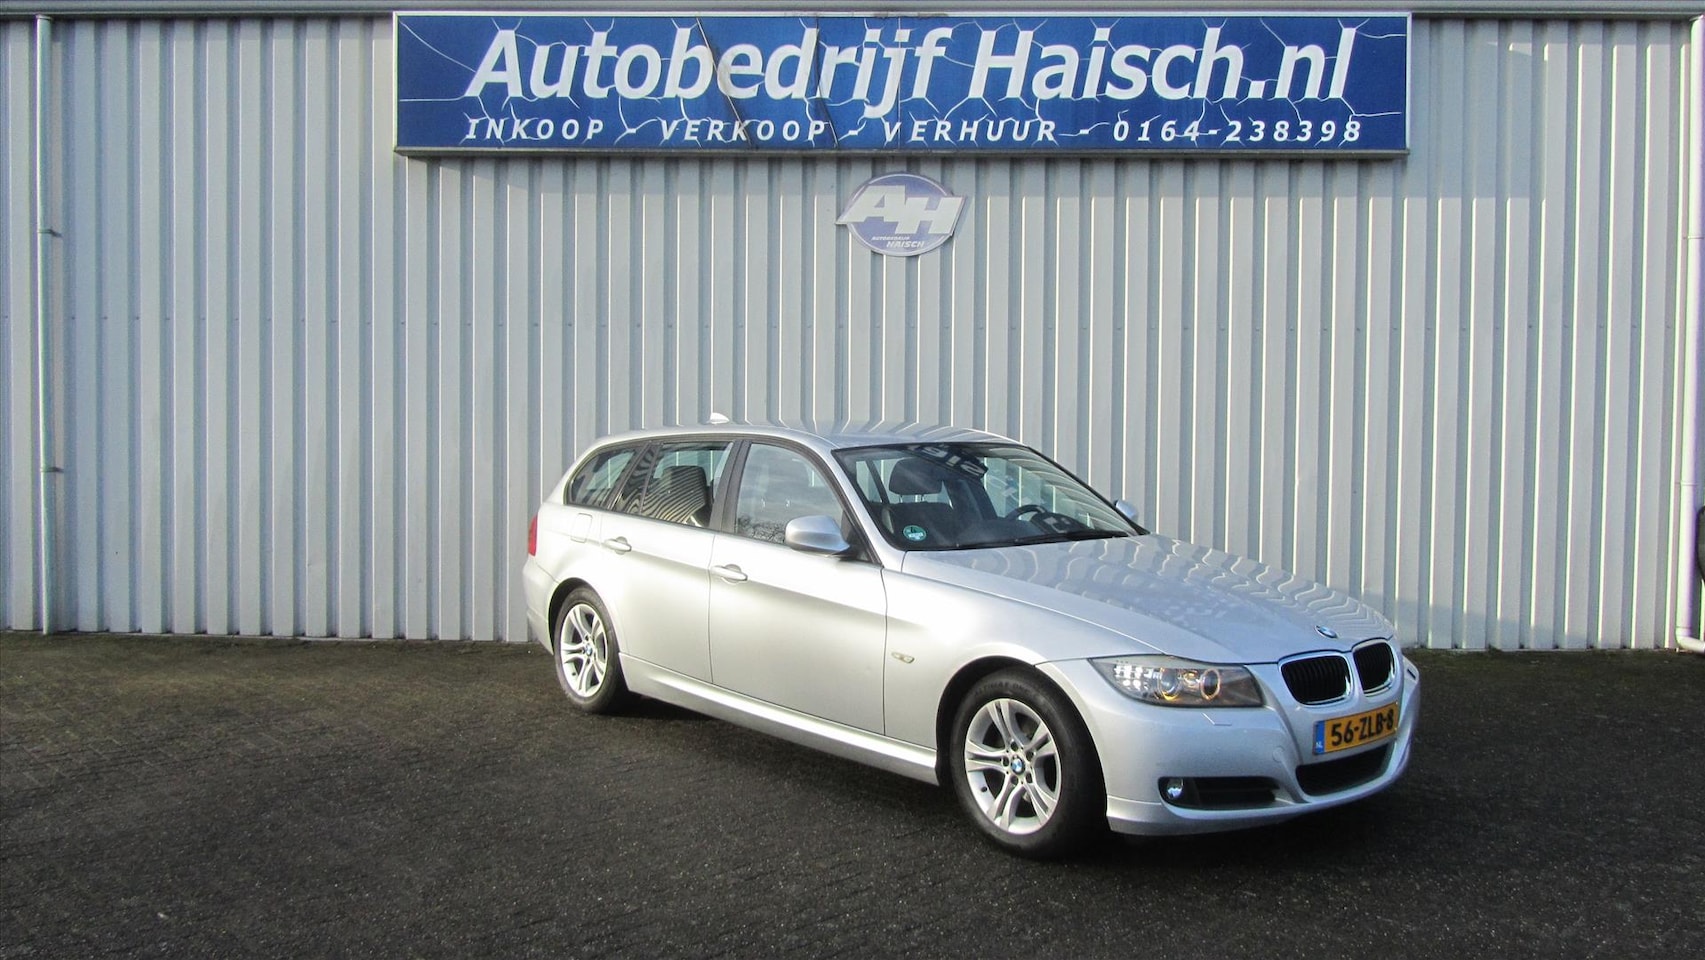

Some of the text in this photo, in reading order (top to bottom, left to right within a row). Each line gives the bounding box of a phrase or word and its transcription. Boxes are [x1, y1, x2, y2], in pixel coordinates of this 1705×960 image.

[464, 27, 1357, 118] Autobedrijf Haisch.nl
[466, 119, 603, 140] INKOOP
[660, 119, 826, 141] VERKOOP
[883, 120, 1056, 141] VERHUUR
[1112, 120, 1361, 141] 0164-238398
[835, 185, 964, 235] AH
[1331, 708, 1395, 747] 56-ZLB-8
